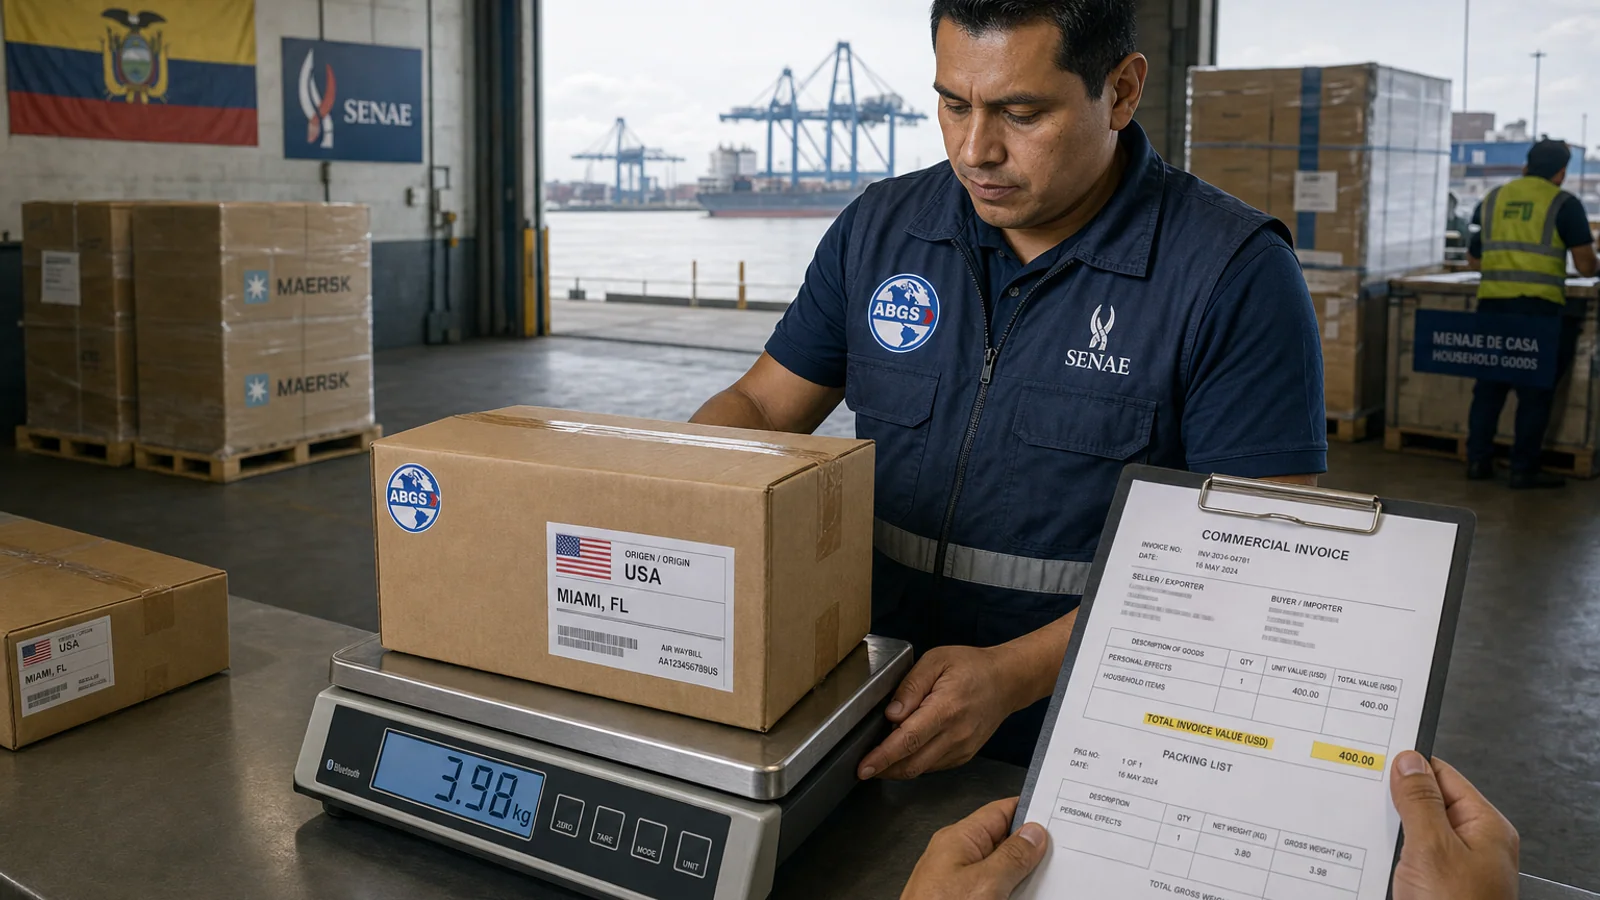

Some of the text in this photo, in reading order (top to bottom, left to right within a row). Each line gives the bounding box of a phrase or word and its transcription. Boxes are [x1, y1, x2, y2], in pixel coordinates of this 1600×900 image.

[344, 98, 412, 126] SENAE
[277, 275, 352, 296] MAERSK
[872, 301, 920, 322] ABGS
[1433, 331, 1539, 352] MENAJE DE CASA
[1065, 349, 1130, 375] SENAE
[1432, 350, 1537, 370] HOUSEHOLD GOODS
[277, 372, 350, 397] MAERSK
[390, 489, 427, 506] ABGS
[1141, 541, 1169, 551] INVOICE
[1202, 529, 1350, 561] COMMERCIAL INVOICE
[625, 550, 656, 562] ORIGEN
[662, 555, 690, 567] ORIGIN
[1139, 552, 1158, 560] DATE:
[625, 563, 662, 585] USA
[1204, 563, 1221, 572] MAY
[1221, 567, 1238, 575] 2024
[1132, 573, 1159, 584] SELLER
[1165, 578, 1205, 591] EXPORTER
[557, 587, 629, 614] MIAMI, FL
[1271, 595, 1297, 606] BUYER
[1303, 600, 1343, 613] IMPORTER
[59, 639, 80, 653] USA
[661, 644, 703, 659] AIR WAYBILL
[1132, 638, 1172, 651] DESCRIPTION
[1182, 647, 1205, 657] GOODS
[658, 657, 719, 676] AA123456789US
[1108, 653, 1172, 672] PERSONAL EFFECTS
[1239, 657, 1254, 666] QTY
[25, 664, 67, 684] MIAMI, FL
[1271, 664, 1327, 680] UNIT VALUE (USD)
[1103, 672, 1166, 691] HOUSEHOLD ITEMS
[1337, 675, 1398, 693] TOTAL VALUE (USD)
[1292, 687, 1319, 699] 400.00
[1360, 699, 1389, 712] 400.00
[1147, 713, 1268, 748] TOTAL INVOICE VALUE (USD)
[1088, 751, 1101, 759] NO:
[1162, 749, 1233, 772] PACKING LIST
[1339, 750, 1375, 767] 400.00
[1069, 759, 1089, 770] DATE:
[1126, 772, 1141, 782] MAY
[1142, 776, 1159, 786] 2024
[434, 755, 532, 828] 3.98 kg
[1089, 792, 1131, 807] DESCRIPTION
[1059, 806, 1122, 827] PERSONAL EFFECTS
[1177, 813, 1191, 823] QTY
[556, 820, 574, 832] ZERO
[1212, 821, 1268, 842] NET WEIGHT (KG)
[596, 832, 613, 845] TARE
[637, 845, 656, 858] MODE
[1234, 848, 1252, 858] 3.80
[1284, 838, 1353, 862] GROSS WEIGHT (KG)
[682, 859, 700, 871] UNIT
[1309, 865, 1327, 877] 3.98
[1149, 879, 1172, 892] TOTAL
[1173, 885, 1201, 899] GROSS
